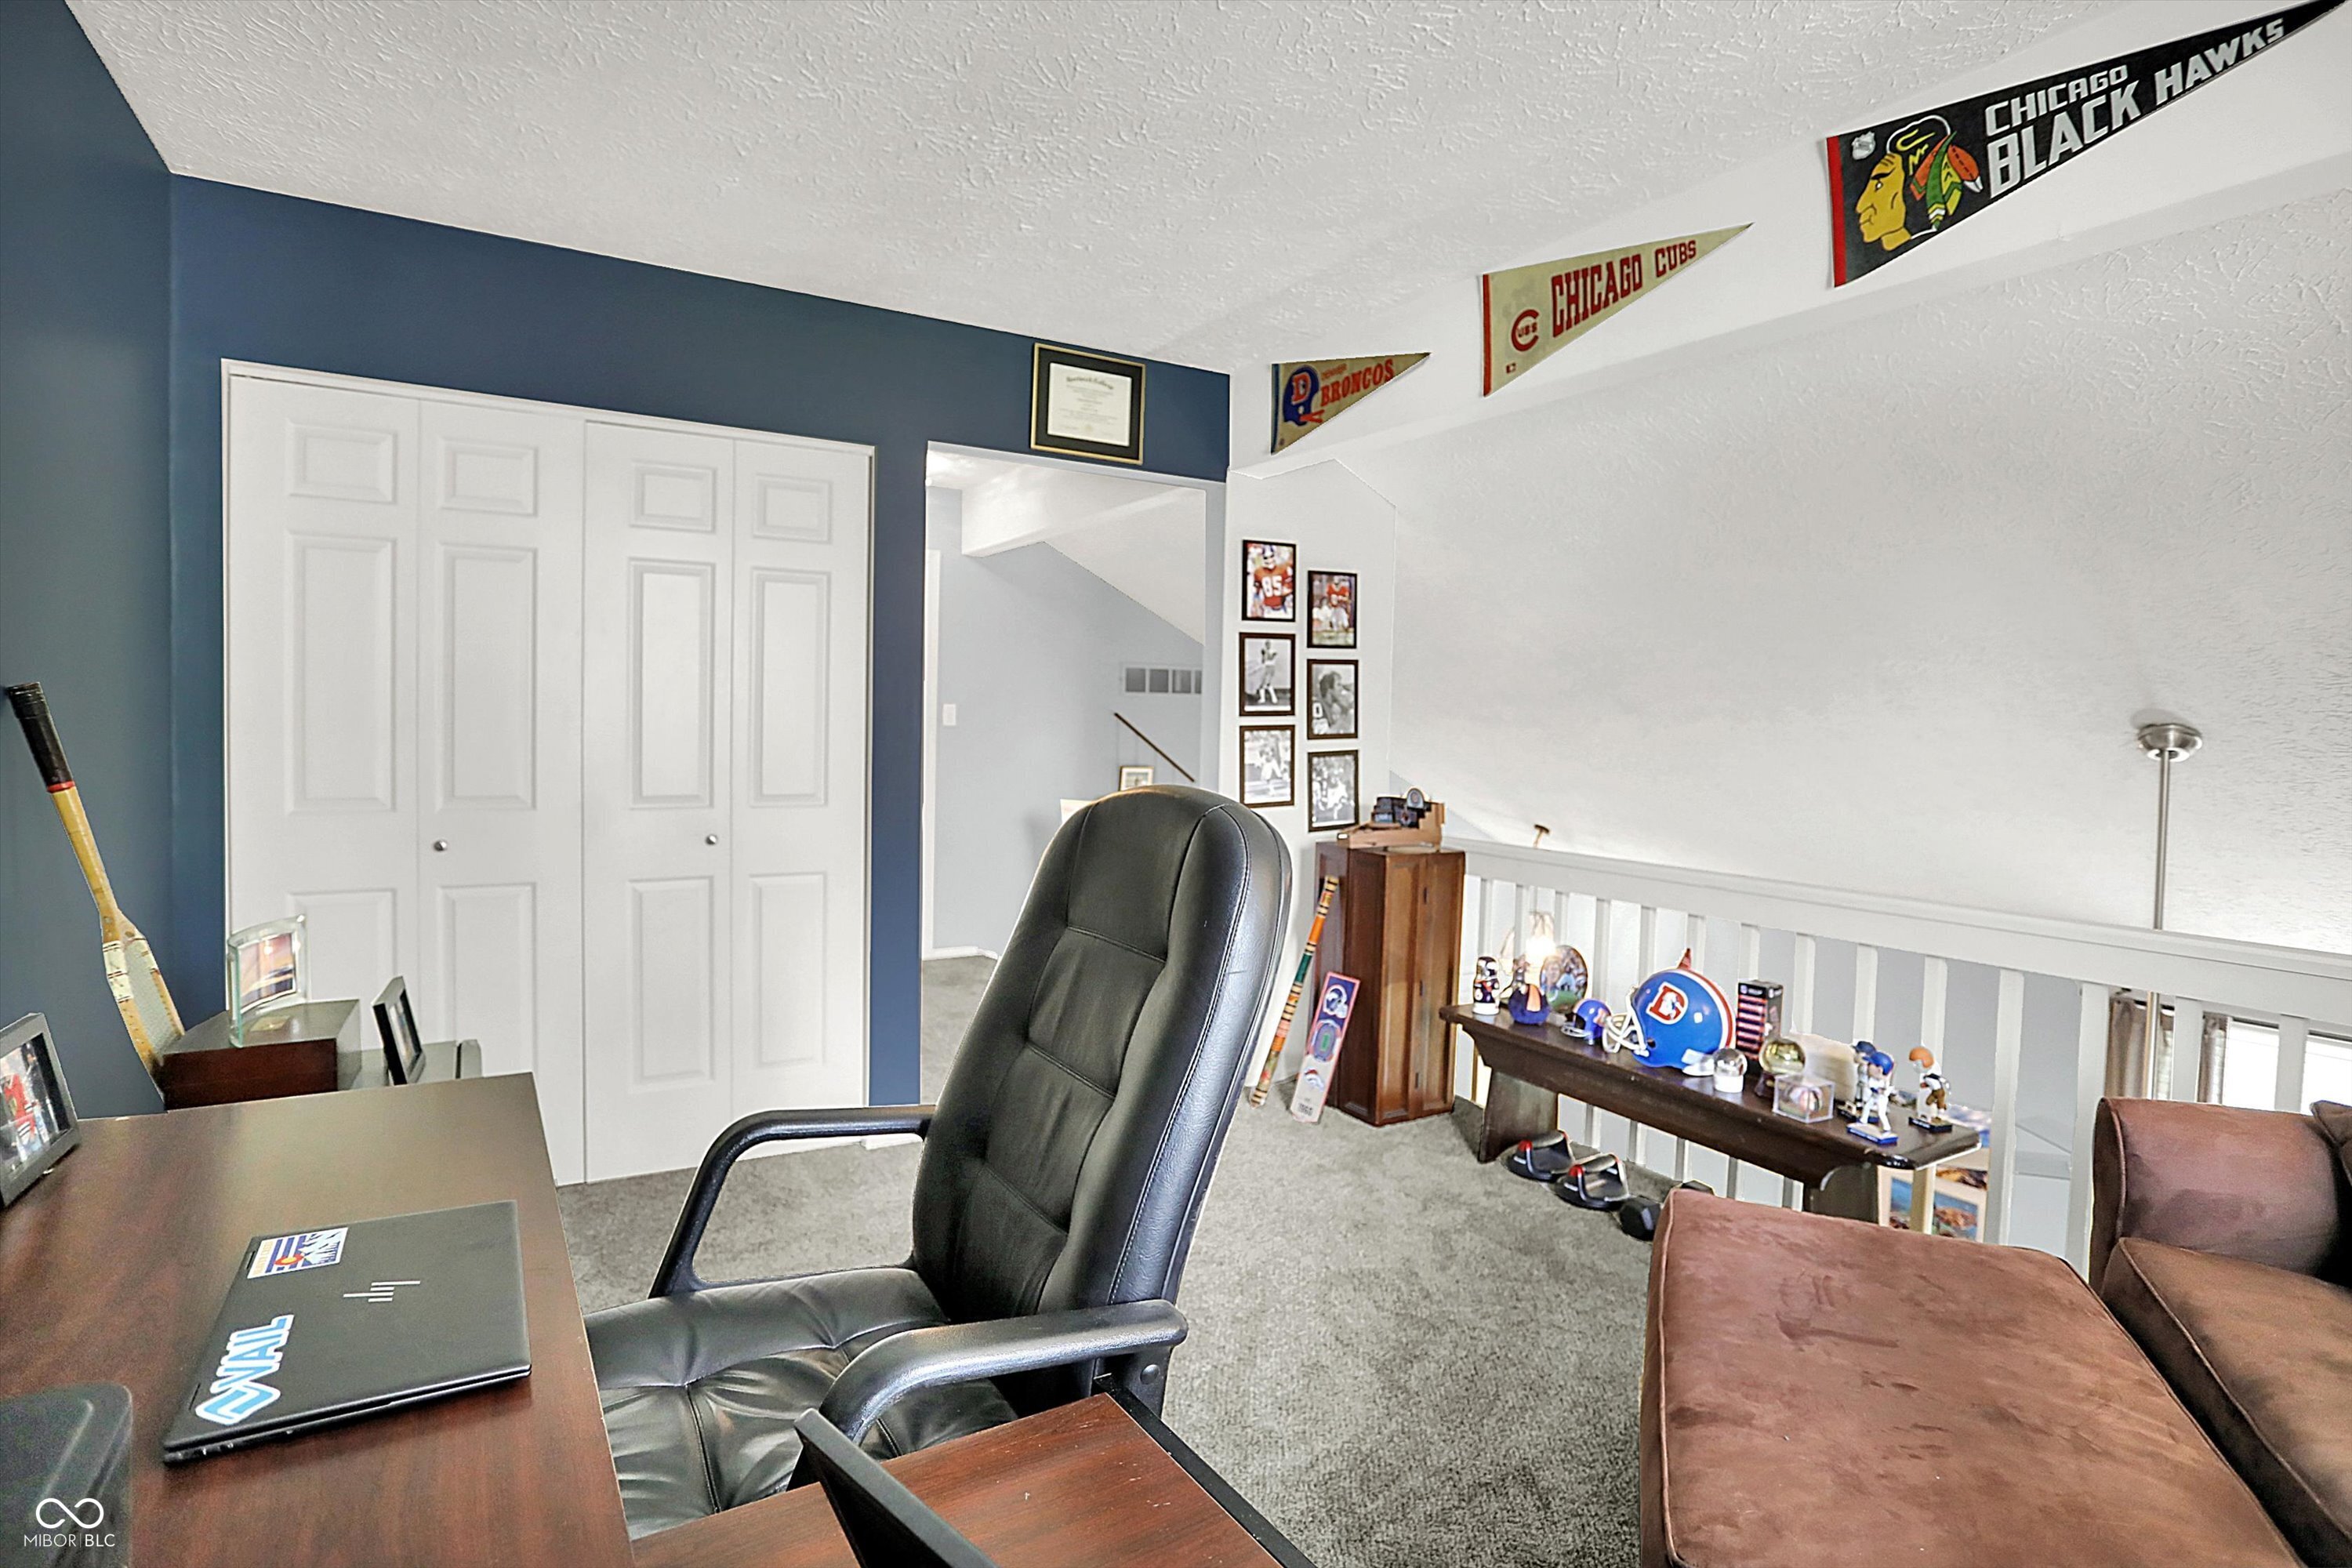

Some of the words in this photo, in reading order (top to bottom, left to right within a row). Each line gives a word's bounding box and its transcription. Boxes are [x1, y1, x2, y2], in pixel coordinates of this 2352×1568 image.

[1985, 64, 2129, 136] CHICAGO
[1987, 80, 2141, 198] BLACK
[2154, 17, 2284, 106] HAWKS
[1551, 253, 1642, 338] CHICAGO
[1654, 239, 1697, 278] CUBS
[1320, 358, 1395, 407] BRONCOS
[1261, 575, 1283, 597] 85
[213, 1316, 291, 1391] VAIL
